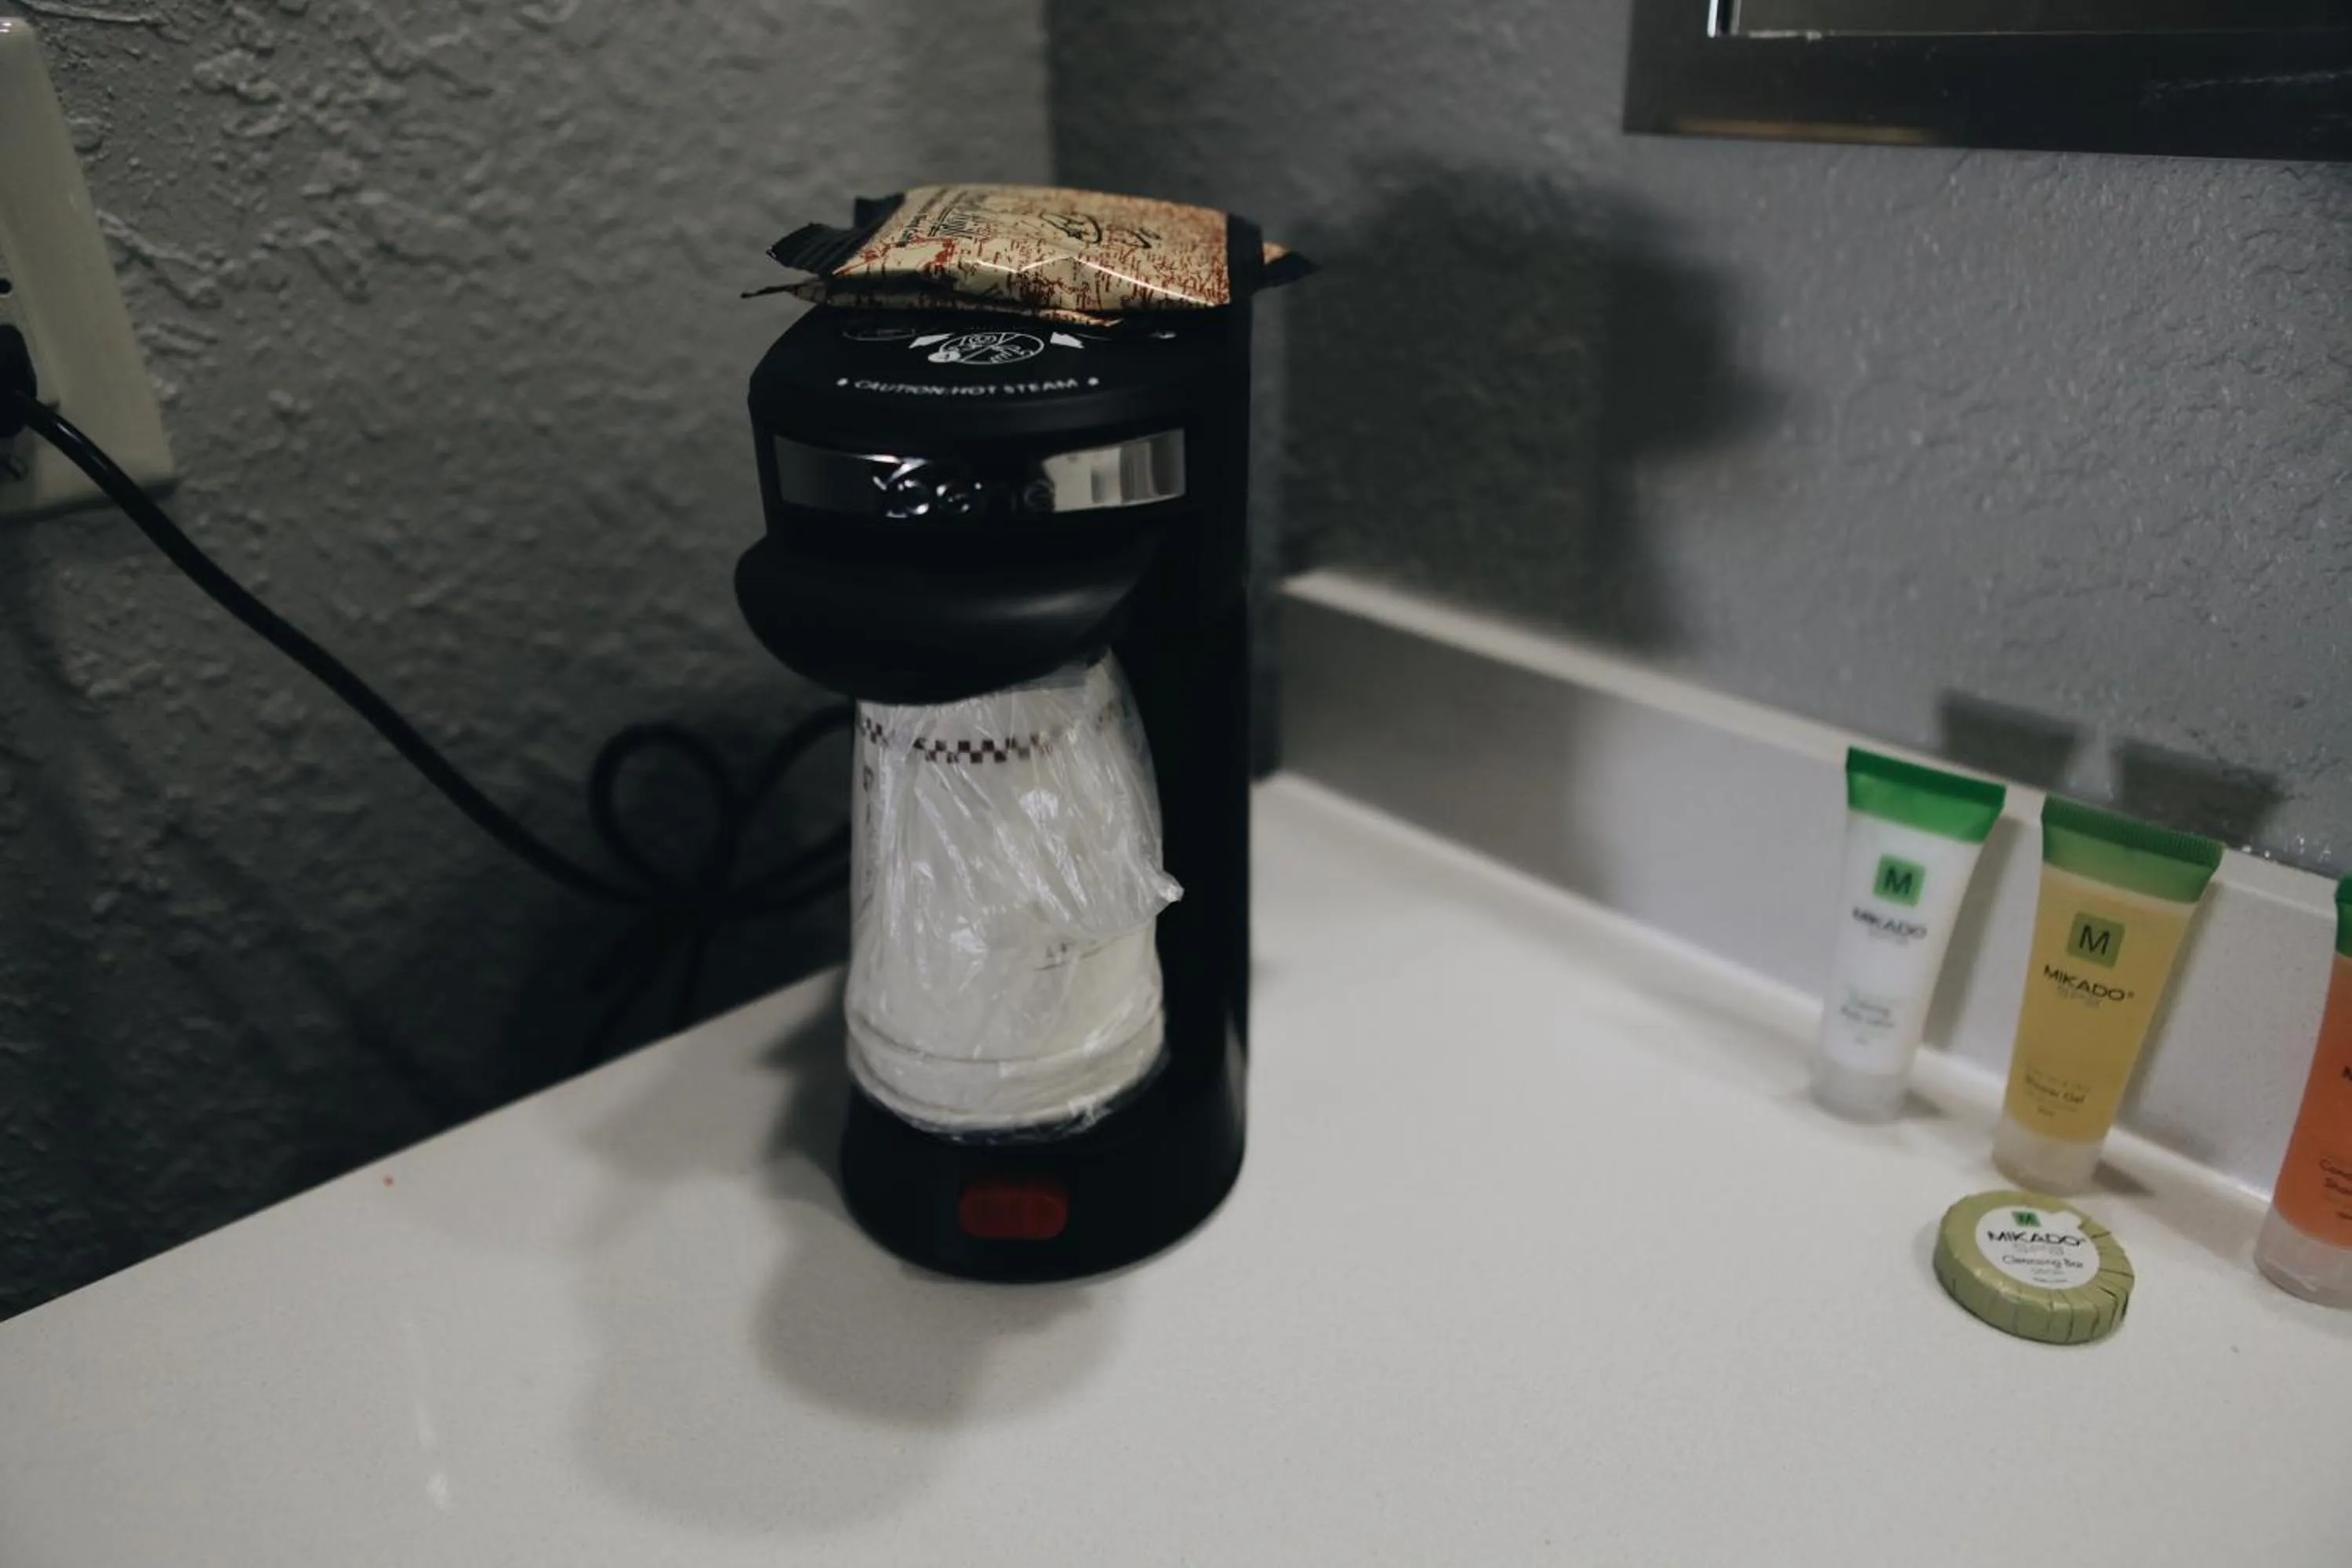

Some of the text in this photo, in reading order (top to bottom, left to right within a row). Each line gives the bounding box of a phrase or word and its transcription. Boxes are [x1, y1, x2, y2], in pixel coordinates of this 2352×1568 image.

[951, 384, 998, 396] HOT
[1003, 377, 1079, 394] STEAM
[1884, 865, 1913, 897] M
[2078, 924, 2111, 955] M
